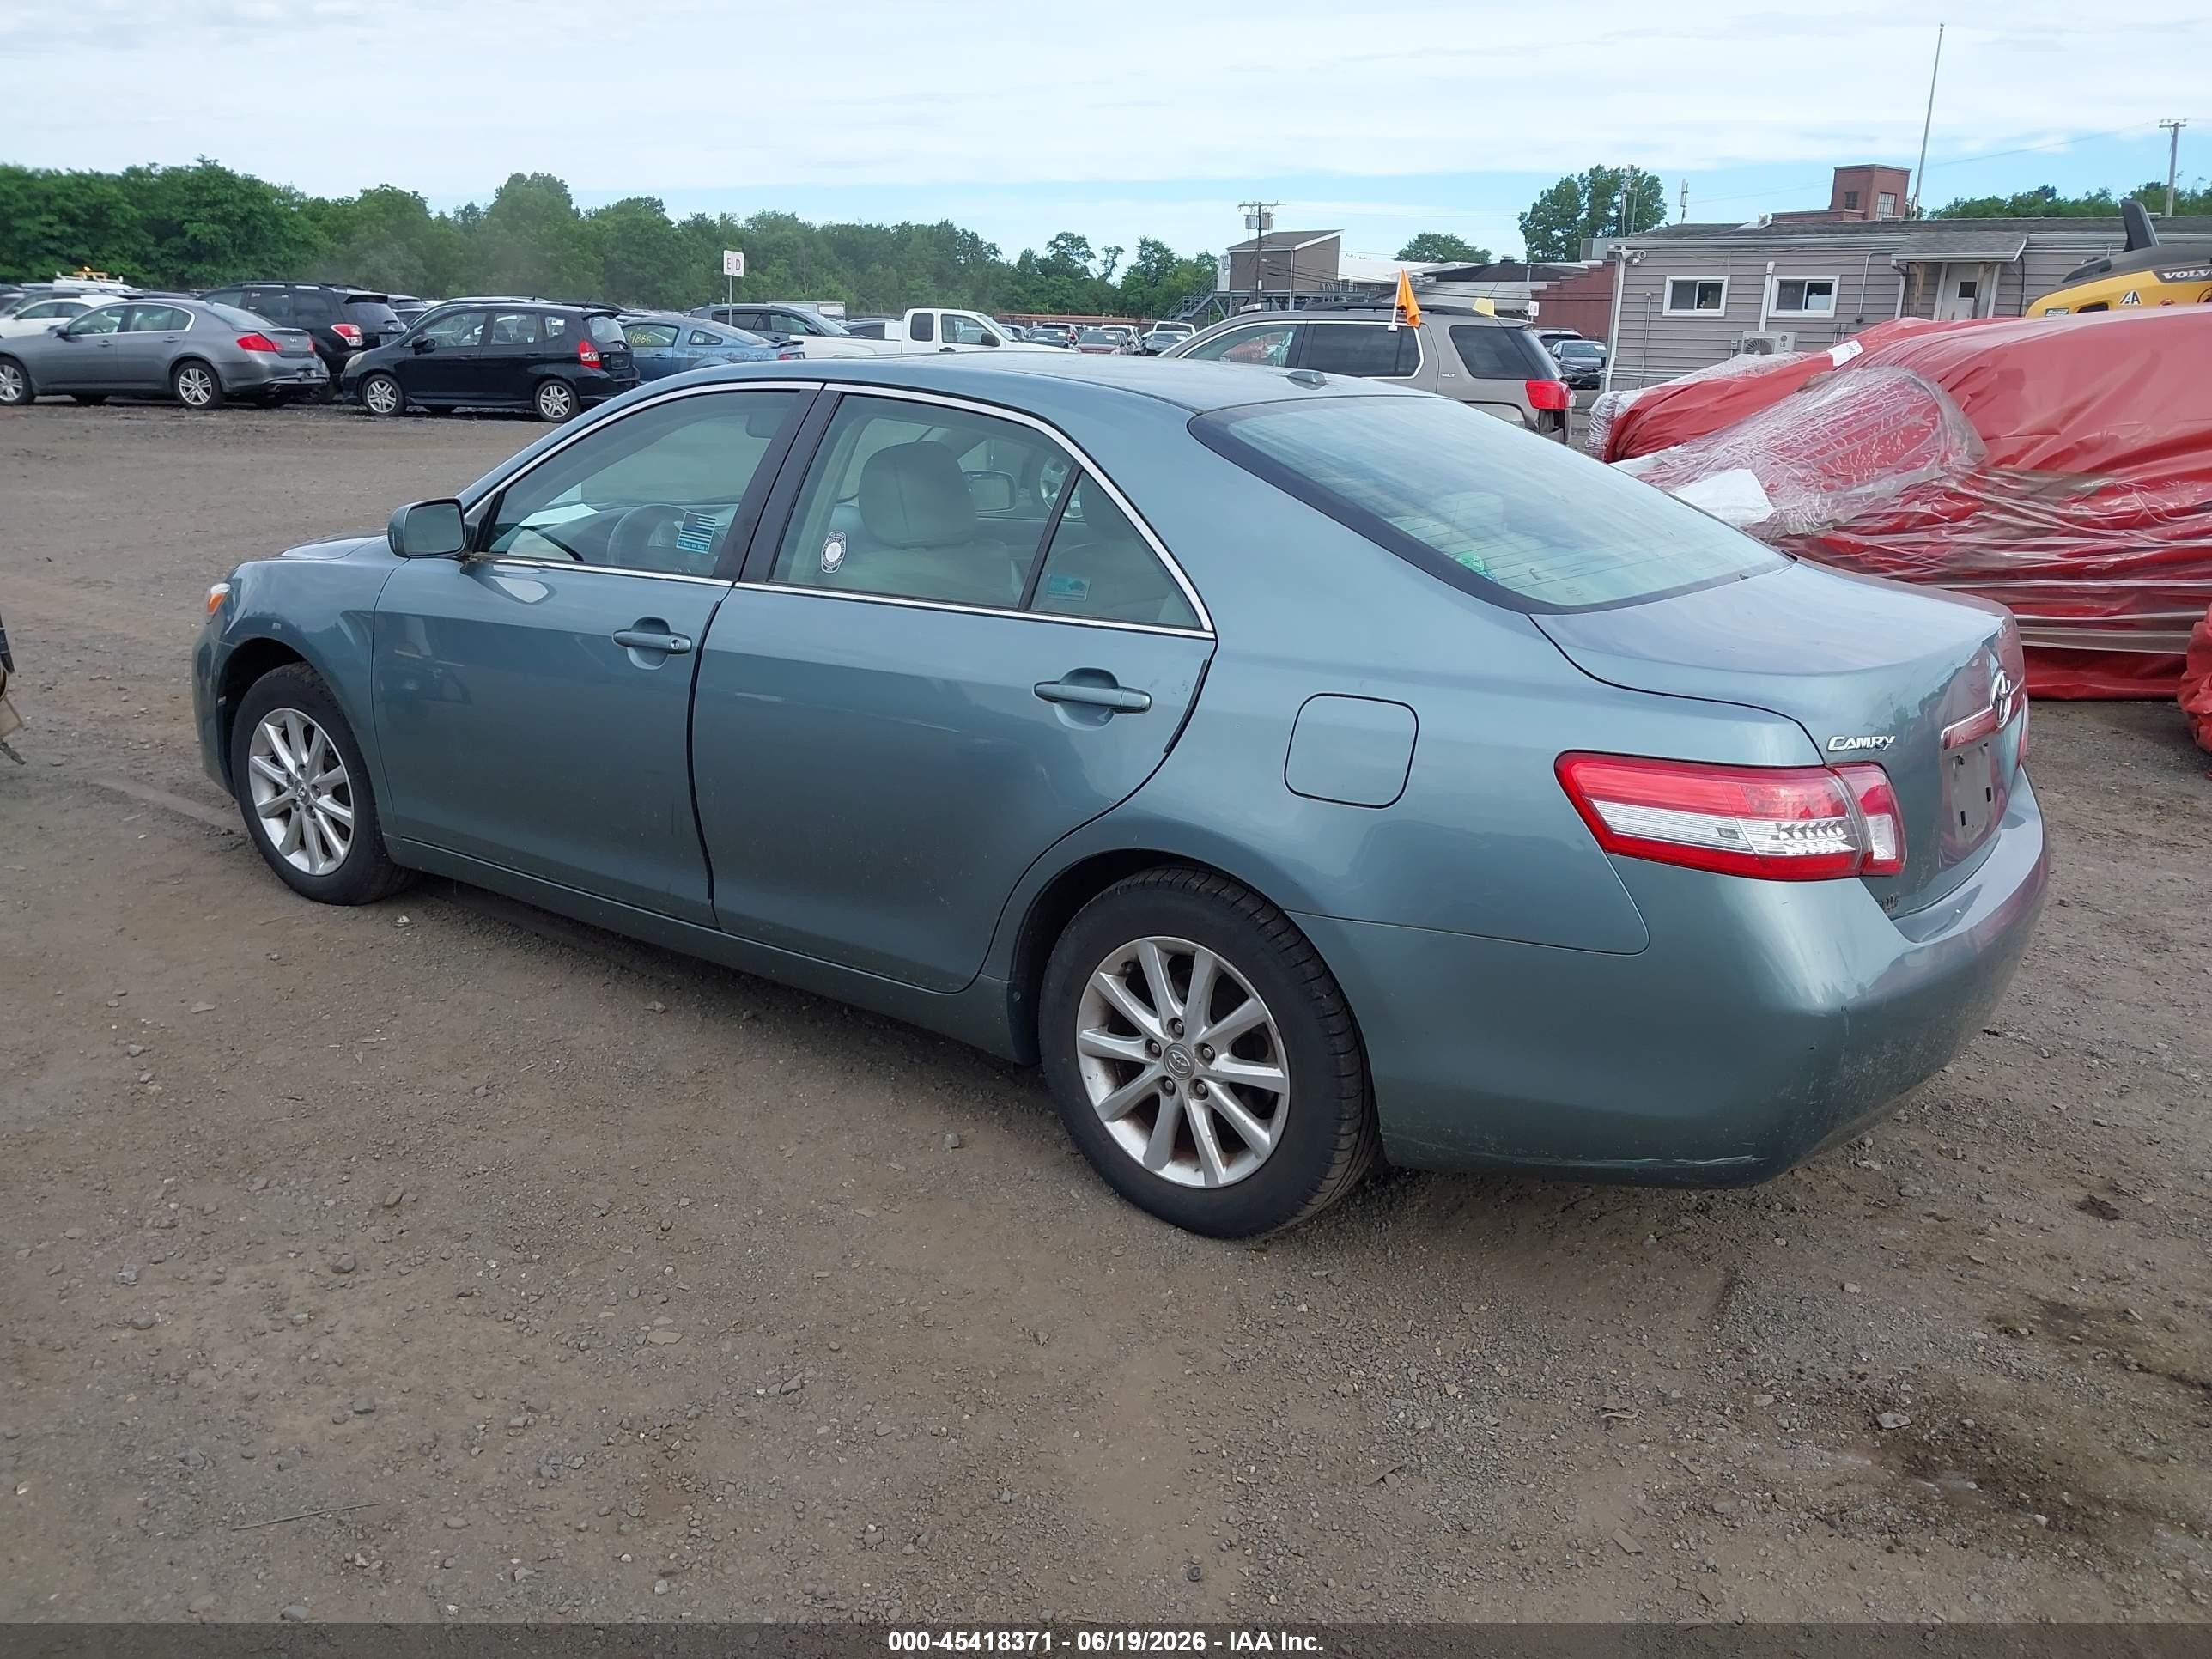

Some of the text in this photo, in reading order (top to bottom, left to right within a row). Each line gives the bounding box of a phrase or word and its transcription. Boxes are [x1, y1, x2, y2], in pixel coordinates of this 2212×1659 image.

[736, 258, 741, 271] D
[2162, 269, 2212, 279] VOLV
[629, 331, 652, 344] 4886
